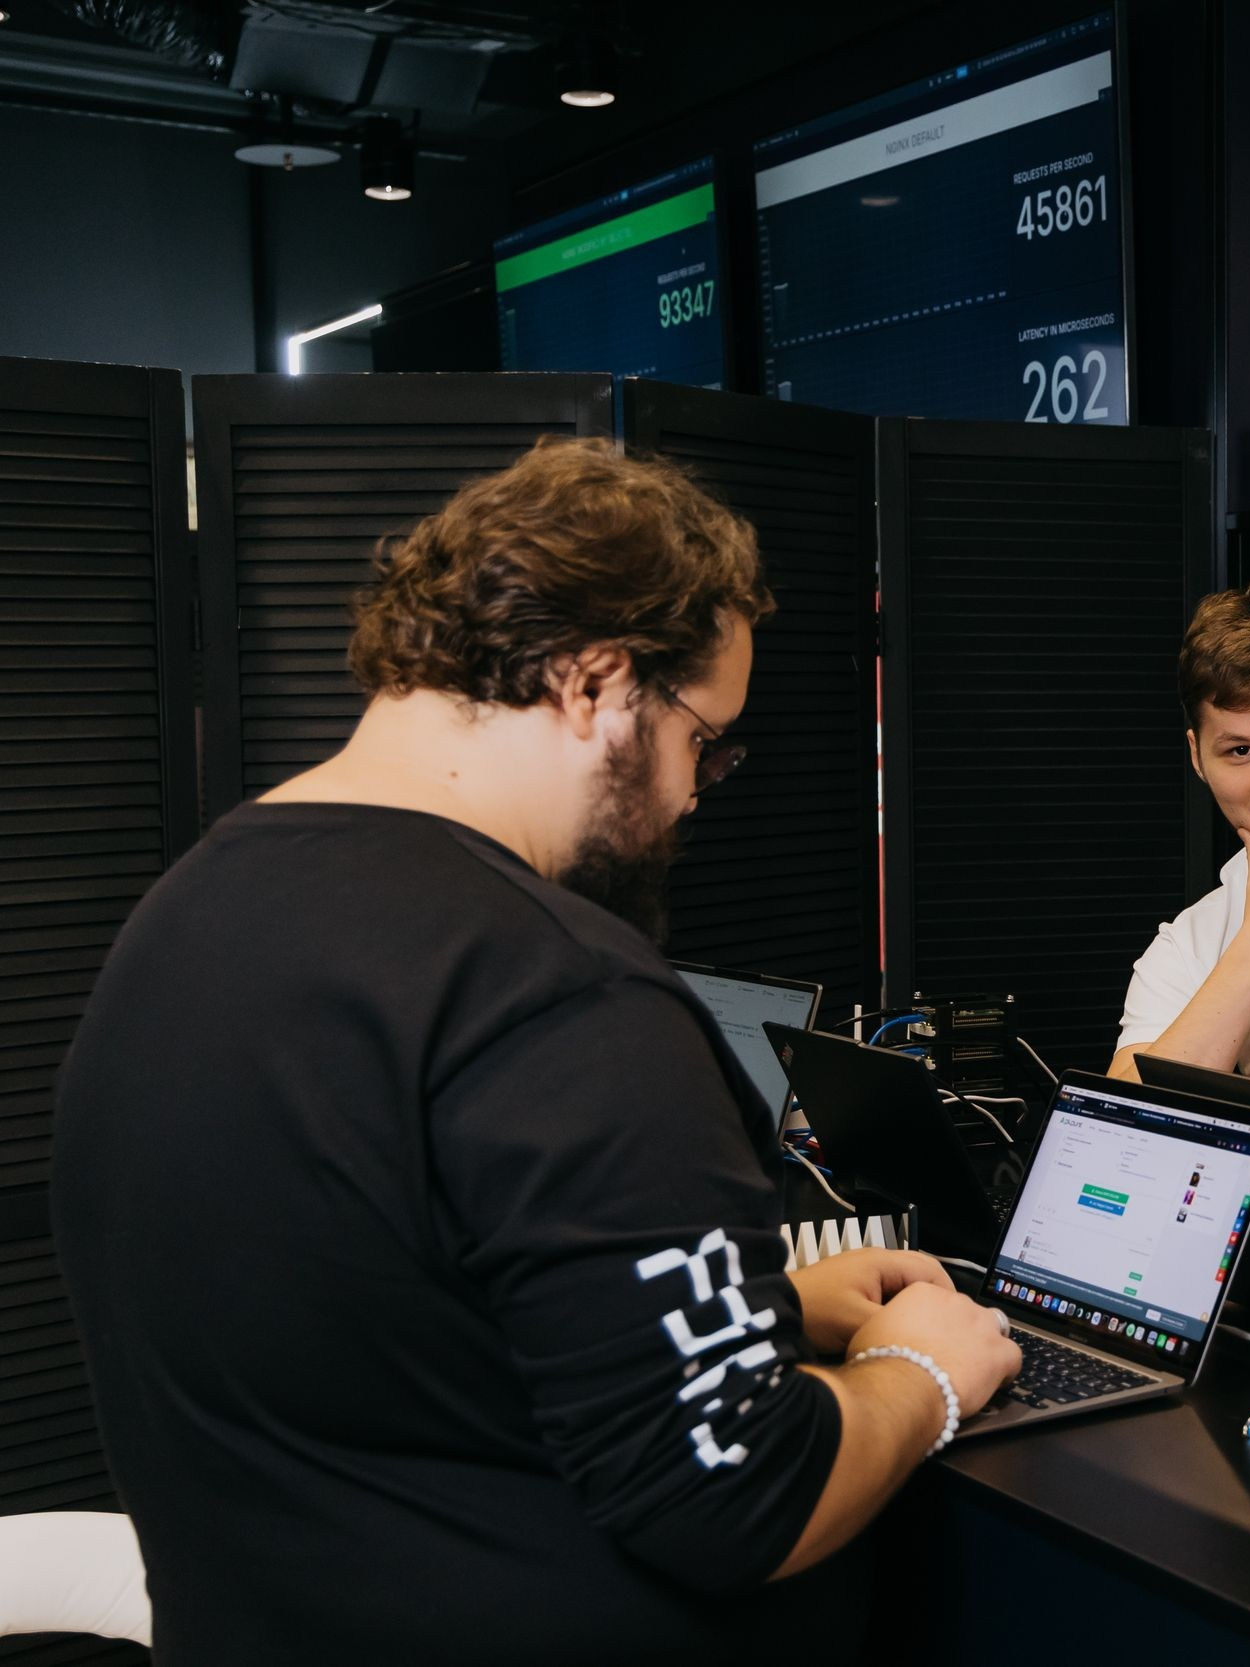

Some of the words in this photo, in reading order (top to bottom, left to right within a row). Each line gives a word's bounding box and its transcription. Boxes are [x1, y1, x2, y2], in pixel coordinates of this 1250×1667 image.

[911, 125, 945, 148] DEFAULT
[1013, 164, 1049, 185] REQUESTS
[1049, 160, 1064, 175] PER
[1063, 152, 1094, 171] SECOND
[1016, 174, 1108, 240] 45861
[658, 279, 715, 329] 93347
[1018, 323, 1049, 342] LATENCY
[1050, 320, 1058, 336] IN
[1058, 313, 1115, 334] MICROSECONDS
[1022, 350, 1109, 424] 262
